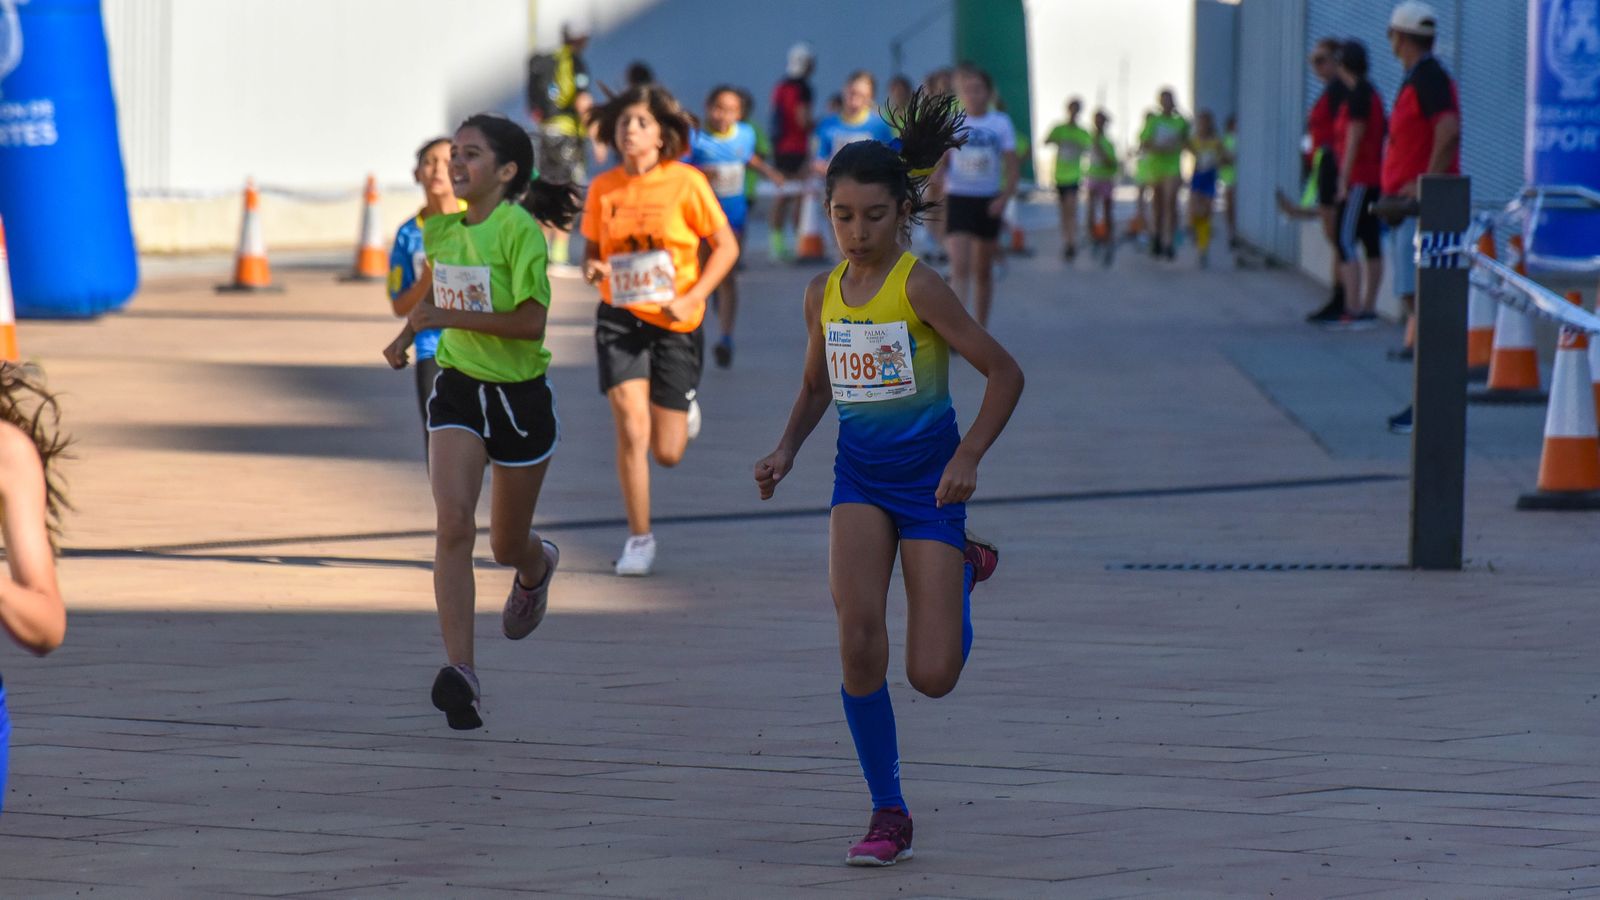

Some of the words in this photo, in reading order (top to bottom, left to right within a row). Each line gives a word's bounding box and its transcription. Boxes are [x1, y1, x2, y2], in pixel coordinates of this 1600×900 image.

[614, 271, 651, 291] 1244
[828, 330, 839, 343] XXI
[831, 351, 877, 380] 1198
